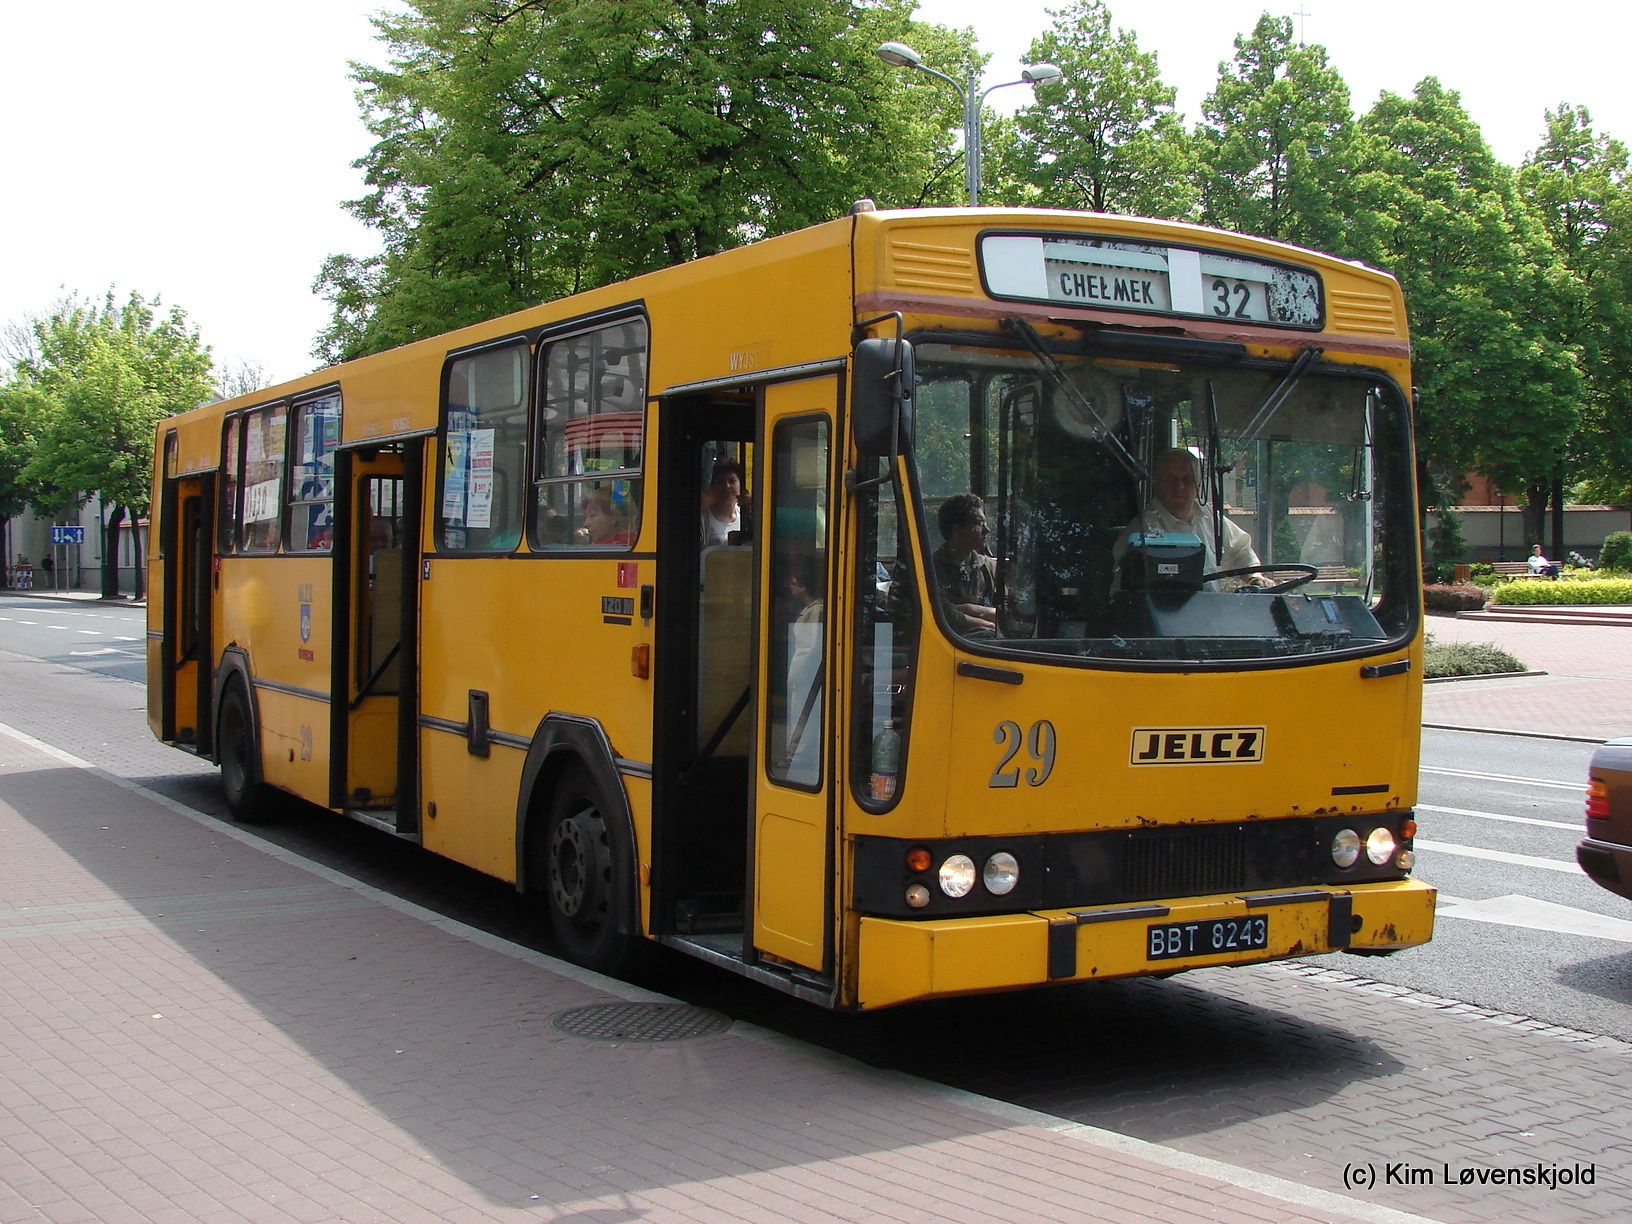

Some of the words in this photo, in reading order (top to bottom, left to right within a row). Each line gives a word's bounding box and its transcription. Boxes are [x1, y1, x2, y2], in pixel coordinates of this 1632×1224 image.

[1060, 272, 1154, 305] CHEŁMEK
[1211, 279, 1251, 319] 32
[603, 597, 622, 614] 120
[623, 598, 633, 615] M
[988, 719, 1057, 788] 29
[1138, 732, 1257, 760] JELCZ
[1150, 925, 1199, 955] BBT
[1211, 919, 1265, 949] 8243
